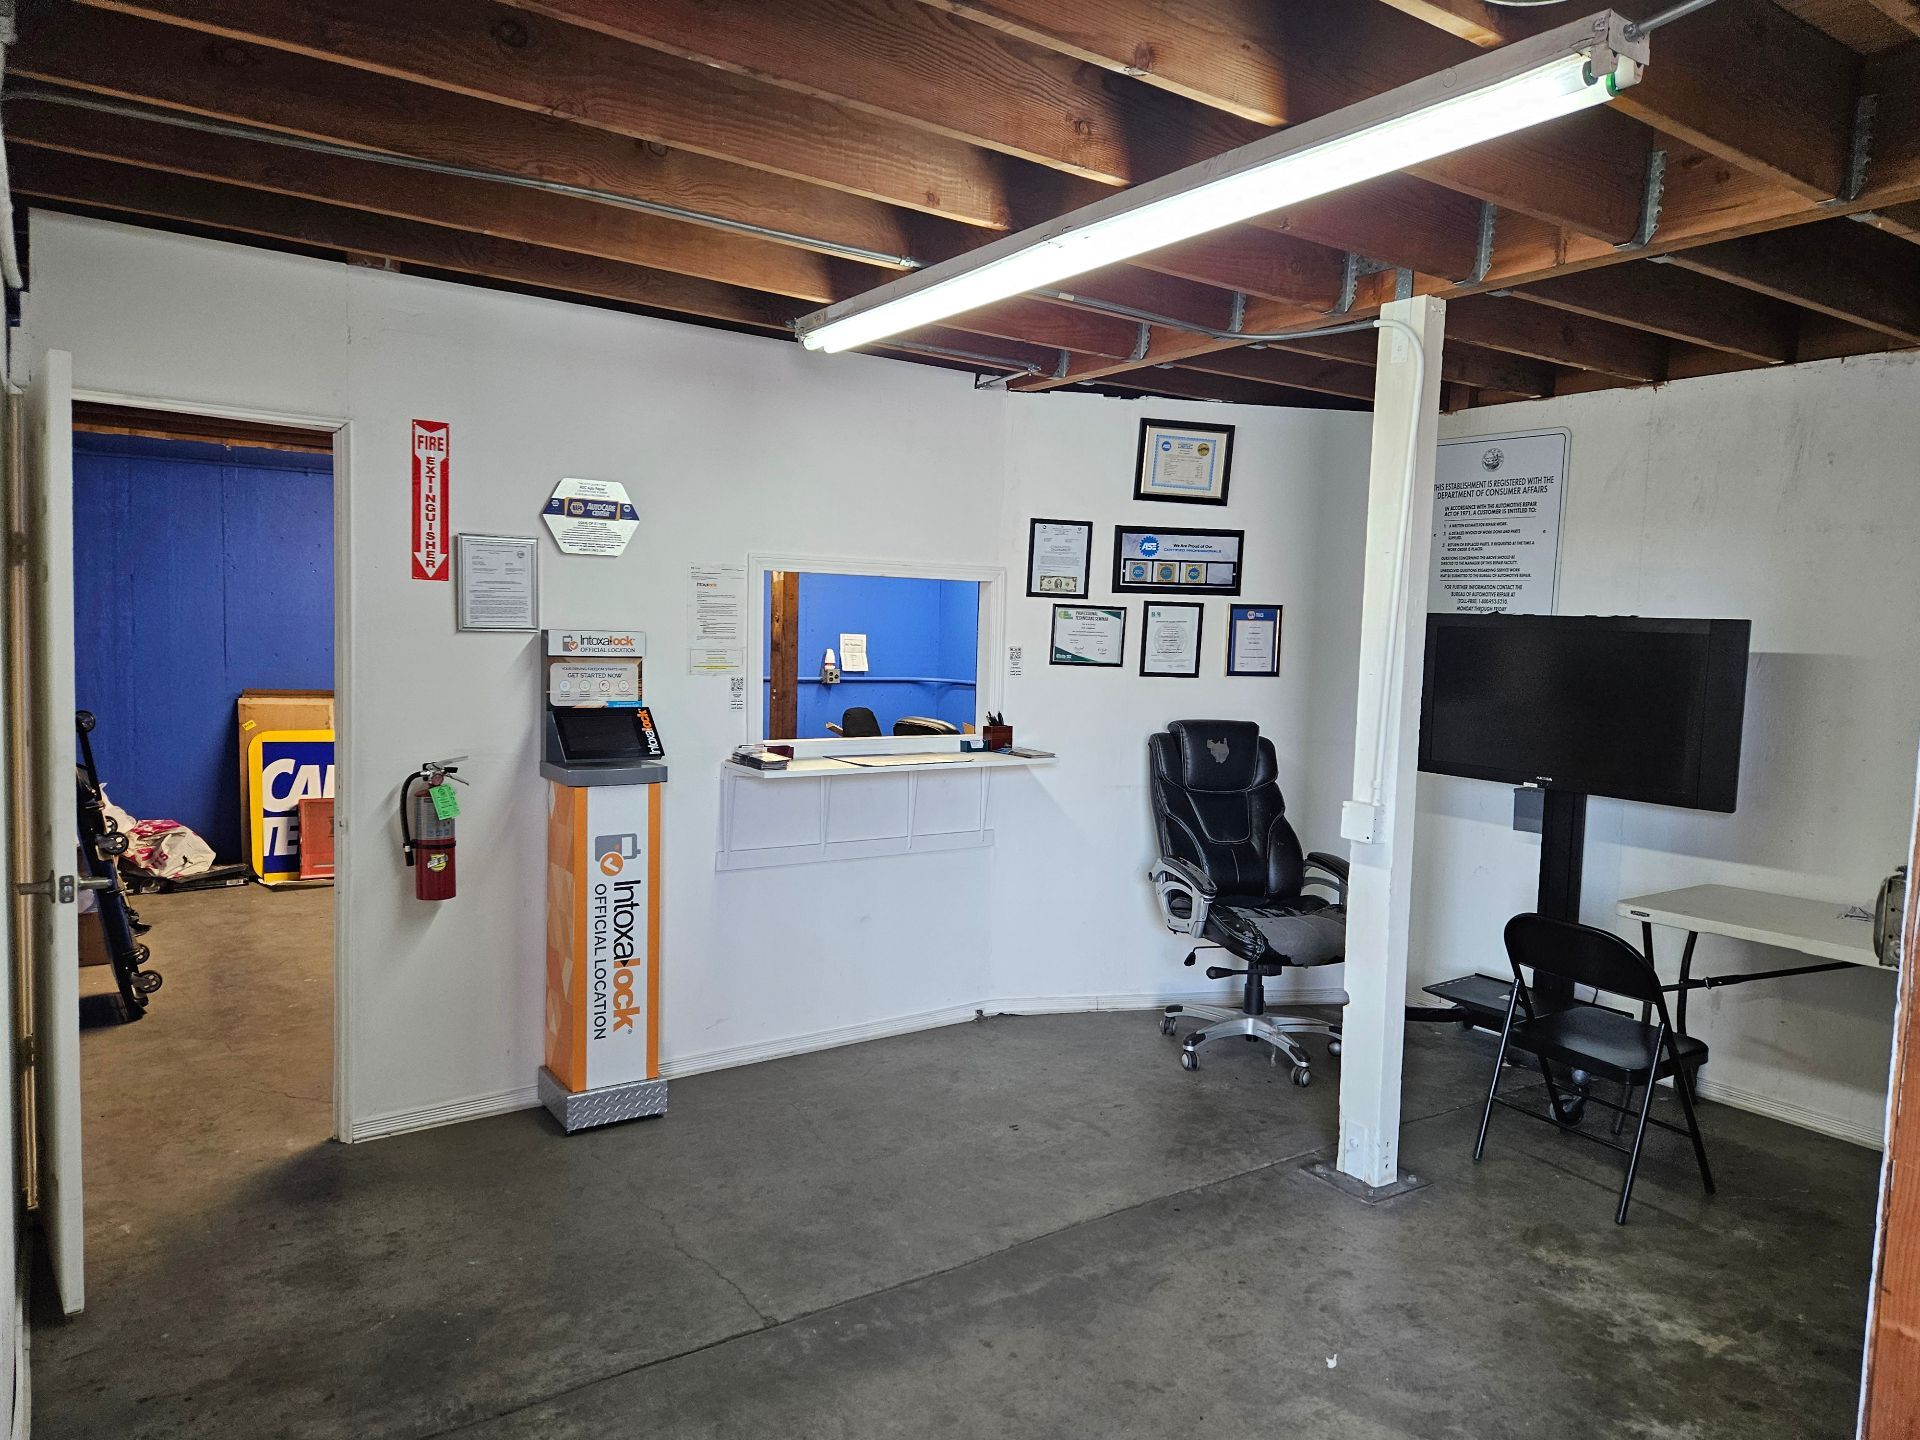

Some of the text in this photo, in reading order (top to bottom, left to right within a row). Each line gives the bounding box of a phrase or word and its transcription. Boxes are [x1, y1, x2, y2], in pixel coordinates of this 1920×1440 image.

[418, 434, 444, 452] FIRE
[1437, 490, 1474, 499] DEPARTMENT
[1486, 487, 1521, 496] CONSUMER
[1522, 485, 1548, 494] AFFAIRS
[1445, 481, 1486, 490] ESTABLISHMENT
[1494, 478, 1526, 487] REGISTERED
[1527, 477, 1542, 485] WITH
[425, 456, 436, 568] EXTINGUISHER
[580, 635, 634, 646] Intoxalock
[594, 883, 607, 1040] OFFICIAL LOCATION
[613, 880, 641, 1032] Intoxalock
